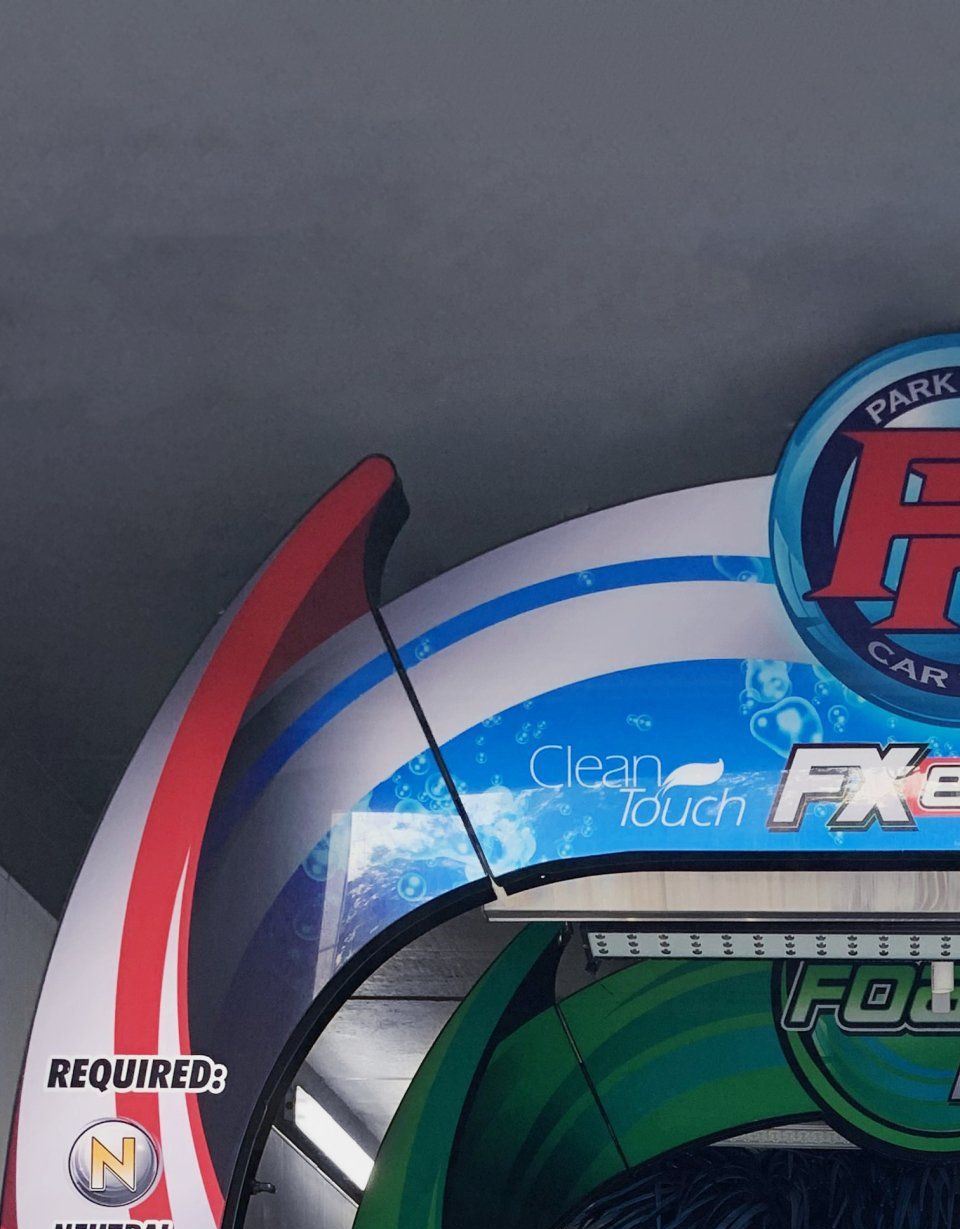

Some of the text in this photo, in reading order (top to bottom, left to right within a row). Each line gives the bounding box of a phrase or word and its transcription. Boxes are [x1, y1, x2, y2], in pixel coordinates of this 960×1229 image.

[865, 373, 957, 426] PARK
[867, 640, 949, 688] CAR
[529, 745, 662, 788] Clean
[767, 742, 931, 832] FX
[619, 788, 746, 827] Touch
[47, 1058, 226, 1092] REQUIRED:
